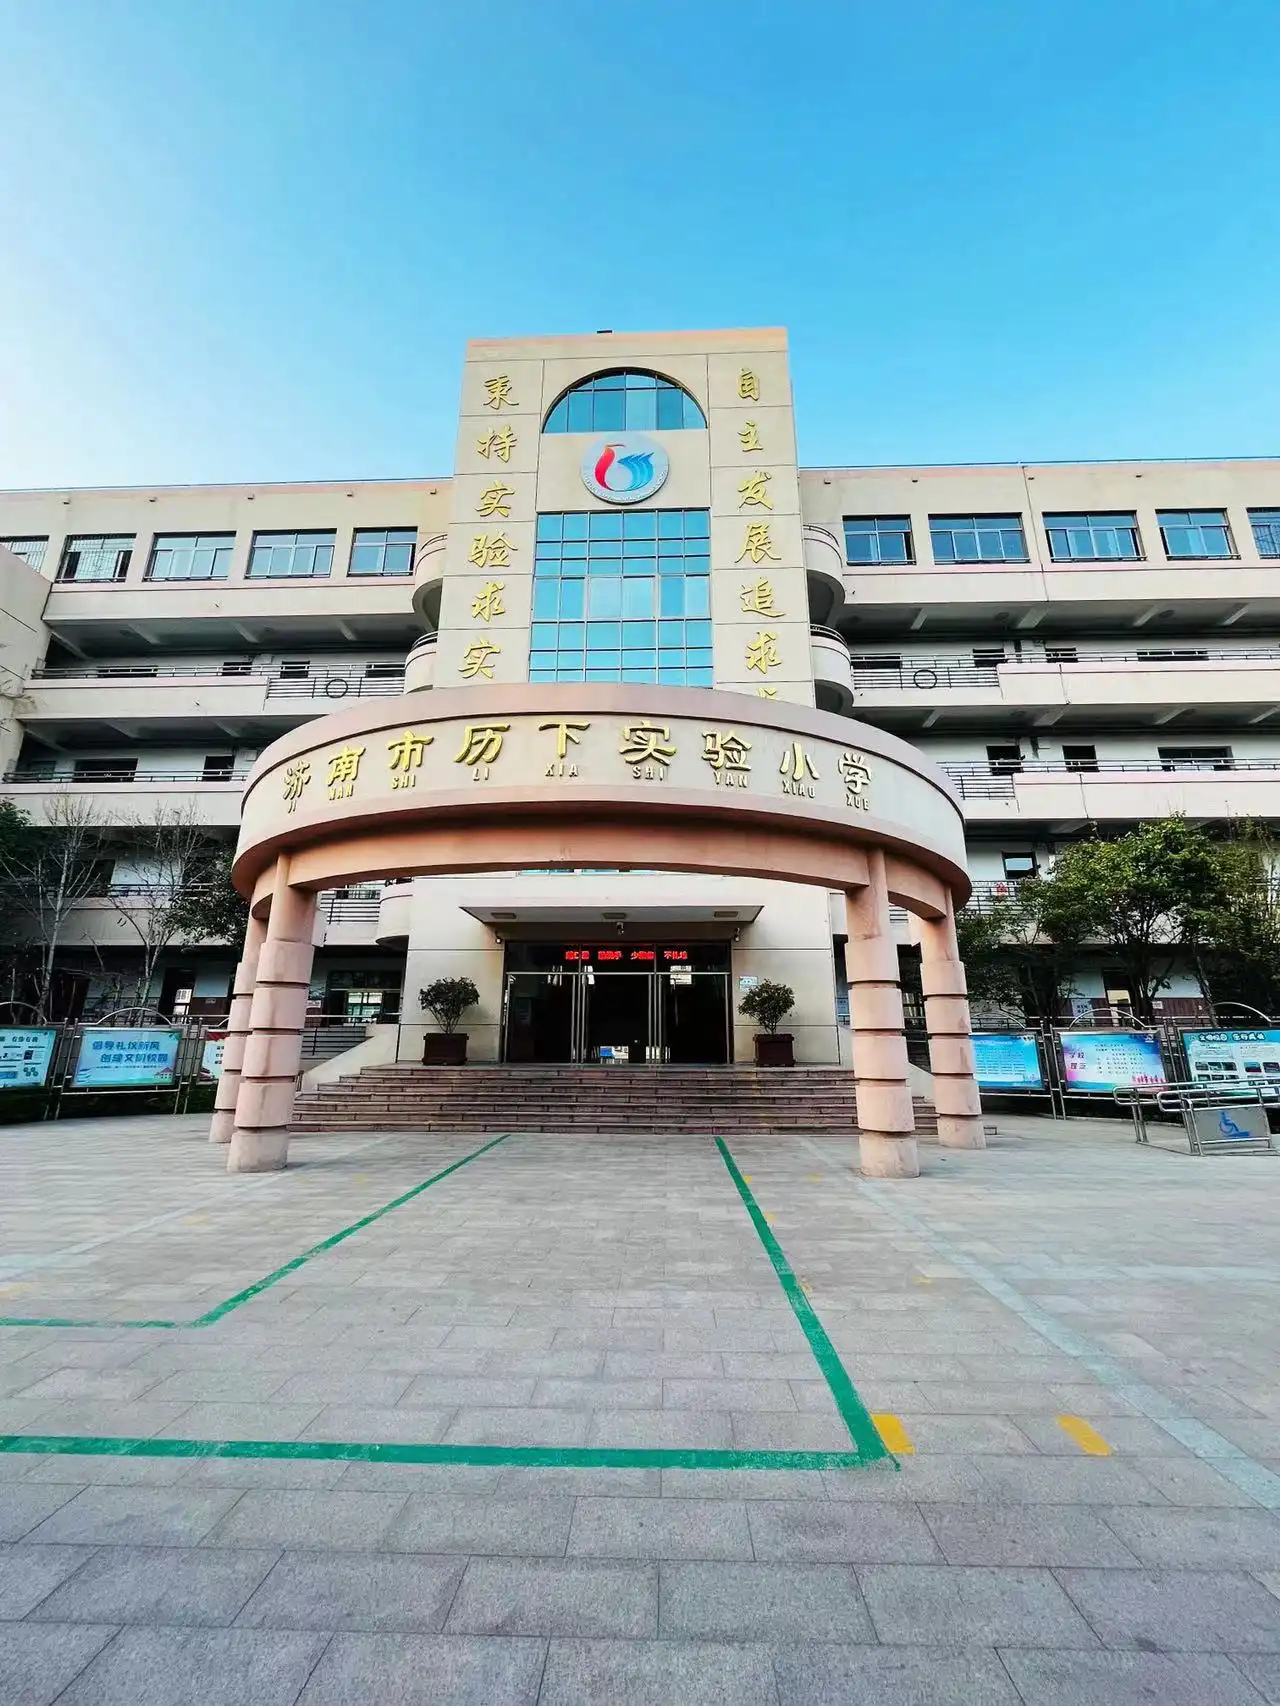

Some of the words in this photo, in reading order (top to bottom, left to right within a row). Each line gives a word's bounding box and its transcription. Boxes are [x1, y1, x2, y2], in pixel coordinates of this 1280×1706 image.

[458, 375, 519, 679] 秉持实验求实
[283, 720, 873, 800] 济南市历下实验小学
[287, 801, 297, 815] JI
[327, 784, 354, 801] NAN
[390, 774, 416, 790] SHI
[472, 767, 490, 782] LI
[544, 763, 579, 778] XIA
[631, 765, 665, 781] SHI
[713, 770, 748, 789] YAN
[782, 779, 816, 799] XIAO
[845, 792, 870, 811] XUE
